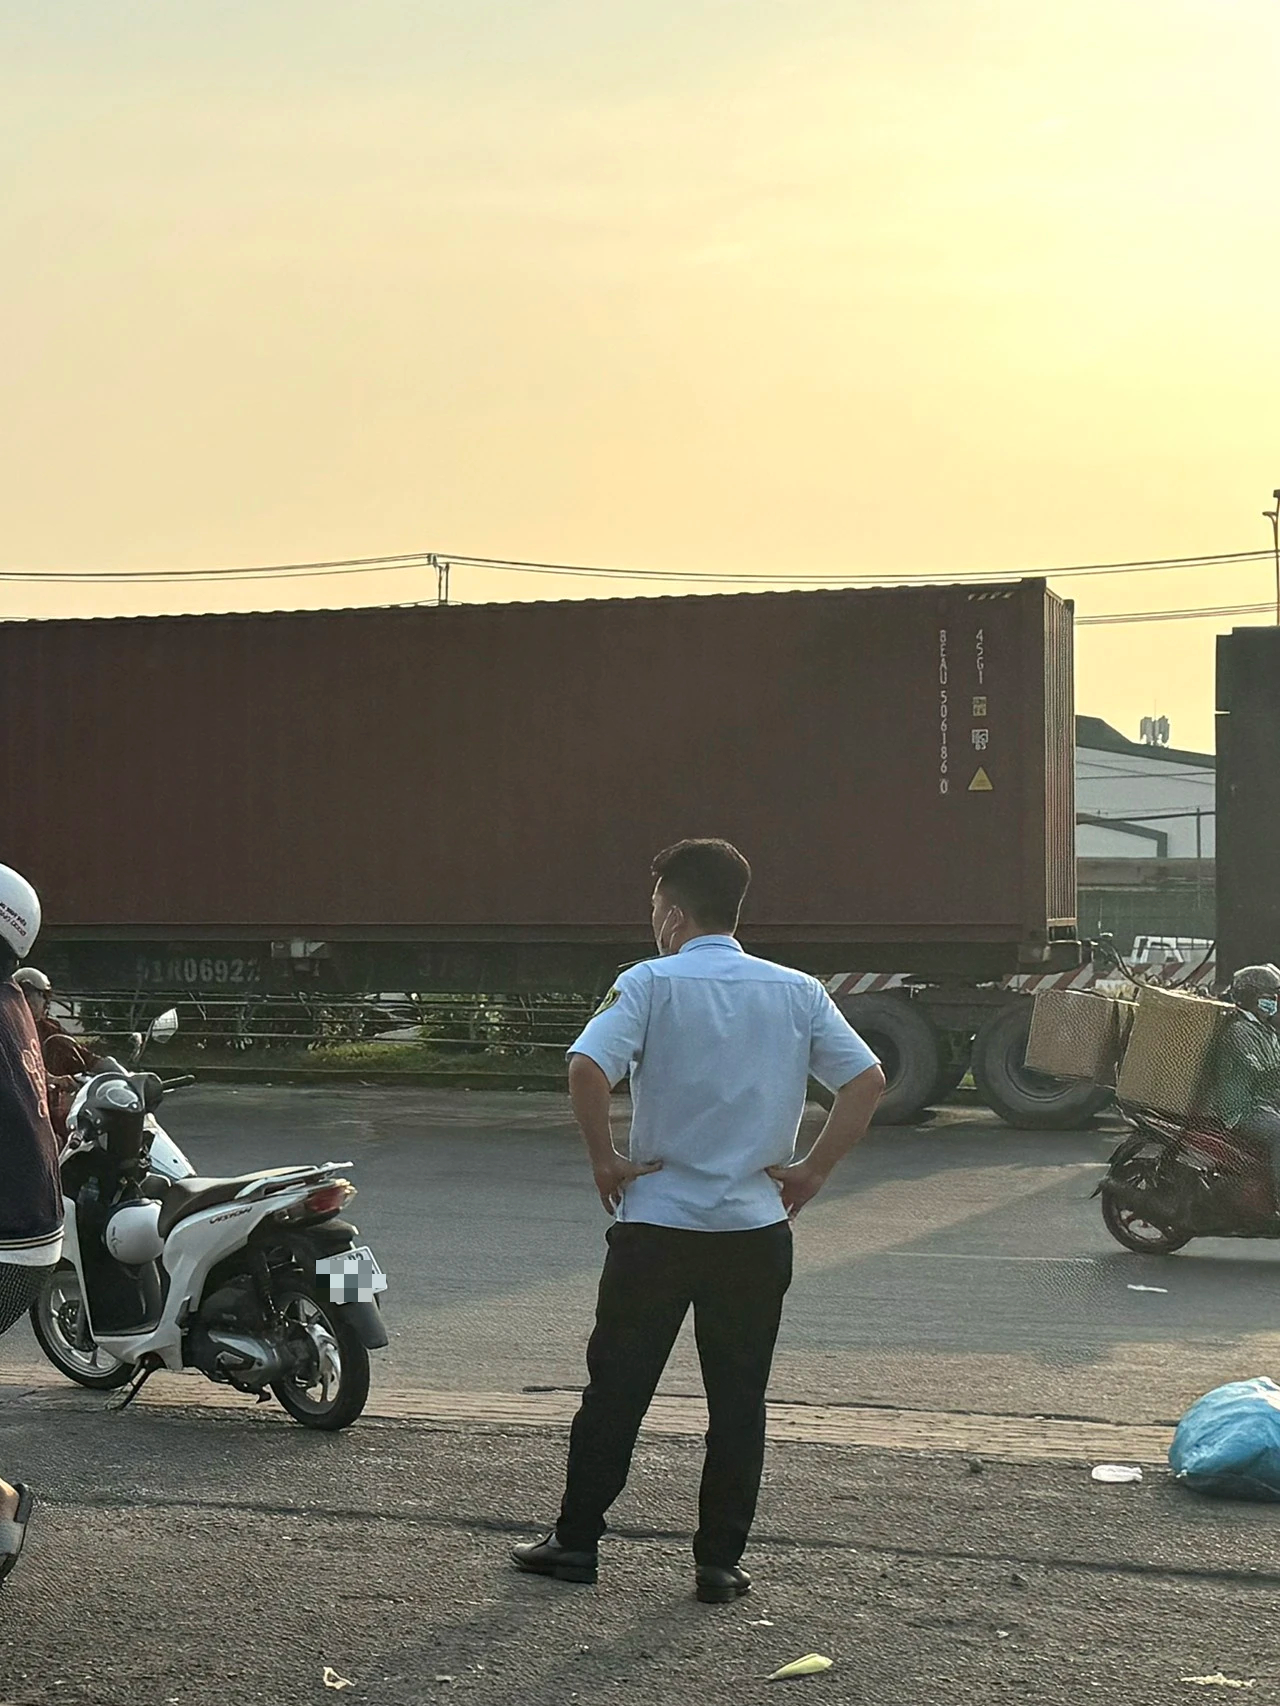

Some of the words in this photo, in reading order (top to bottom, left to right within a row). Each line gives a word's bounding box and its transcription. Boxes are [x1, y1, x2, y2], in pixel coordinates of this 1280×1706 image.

[939, 629, 948, 685] BEAU
[976, 628, 985, 685] 45G1
[940, 690, 948, 774] 506186
